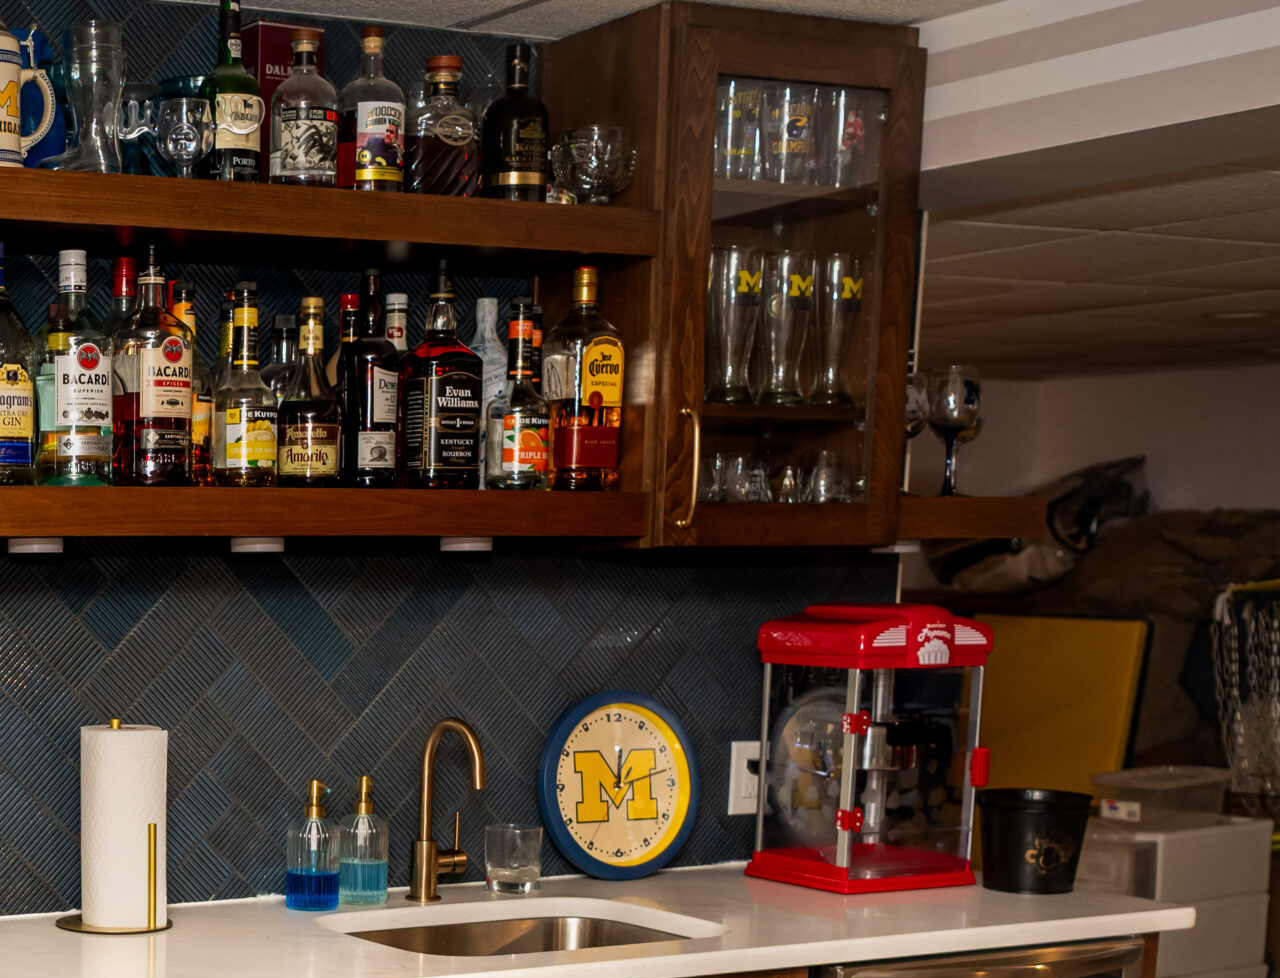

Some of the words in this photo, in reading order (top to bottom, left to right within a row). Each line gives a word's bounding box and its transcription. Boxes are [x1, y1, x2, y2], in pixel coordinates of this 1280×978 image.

[232, 156, 256, 167] PORTO
[738, 270, 761, 293] M
[790, 274, 813, 297] M
[842, 277, 864, 299] M
[589, 361, 620, 376] Cuervo
[445, 386, 472, 397] Evan
[437, 396, 479, 408] Williams
[2, 417, 22, 426] GIN
[605, 713, 623, 723] 12
[556, 783, 565, 792] 9
[667, 778, 675, 788] 3
[573, 748, 658, 824] M
[614, 847, 624, 859] 6
